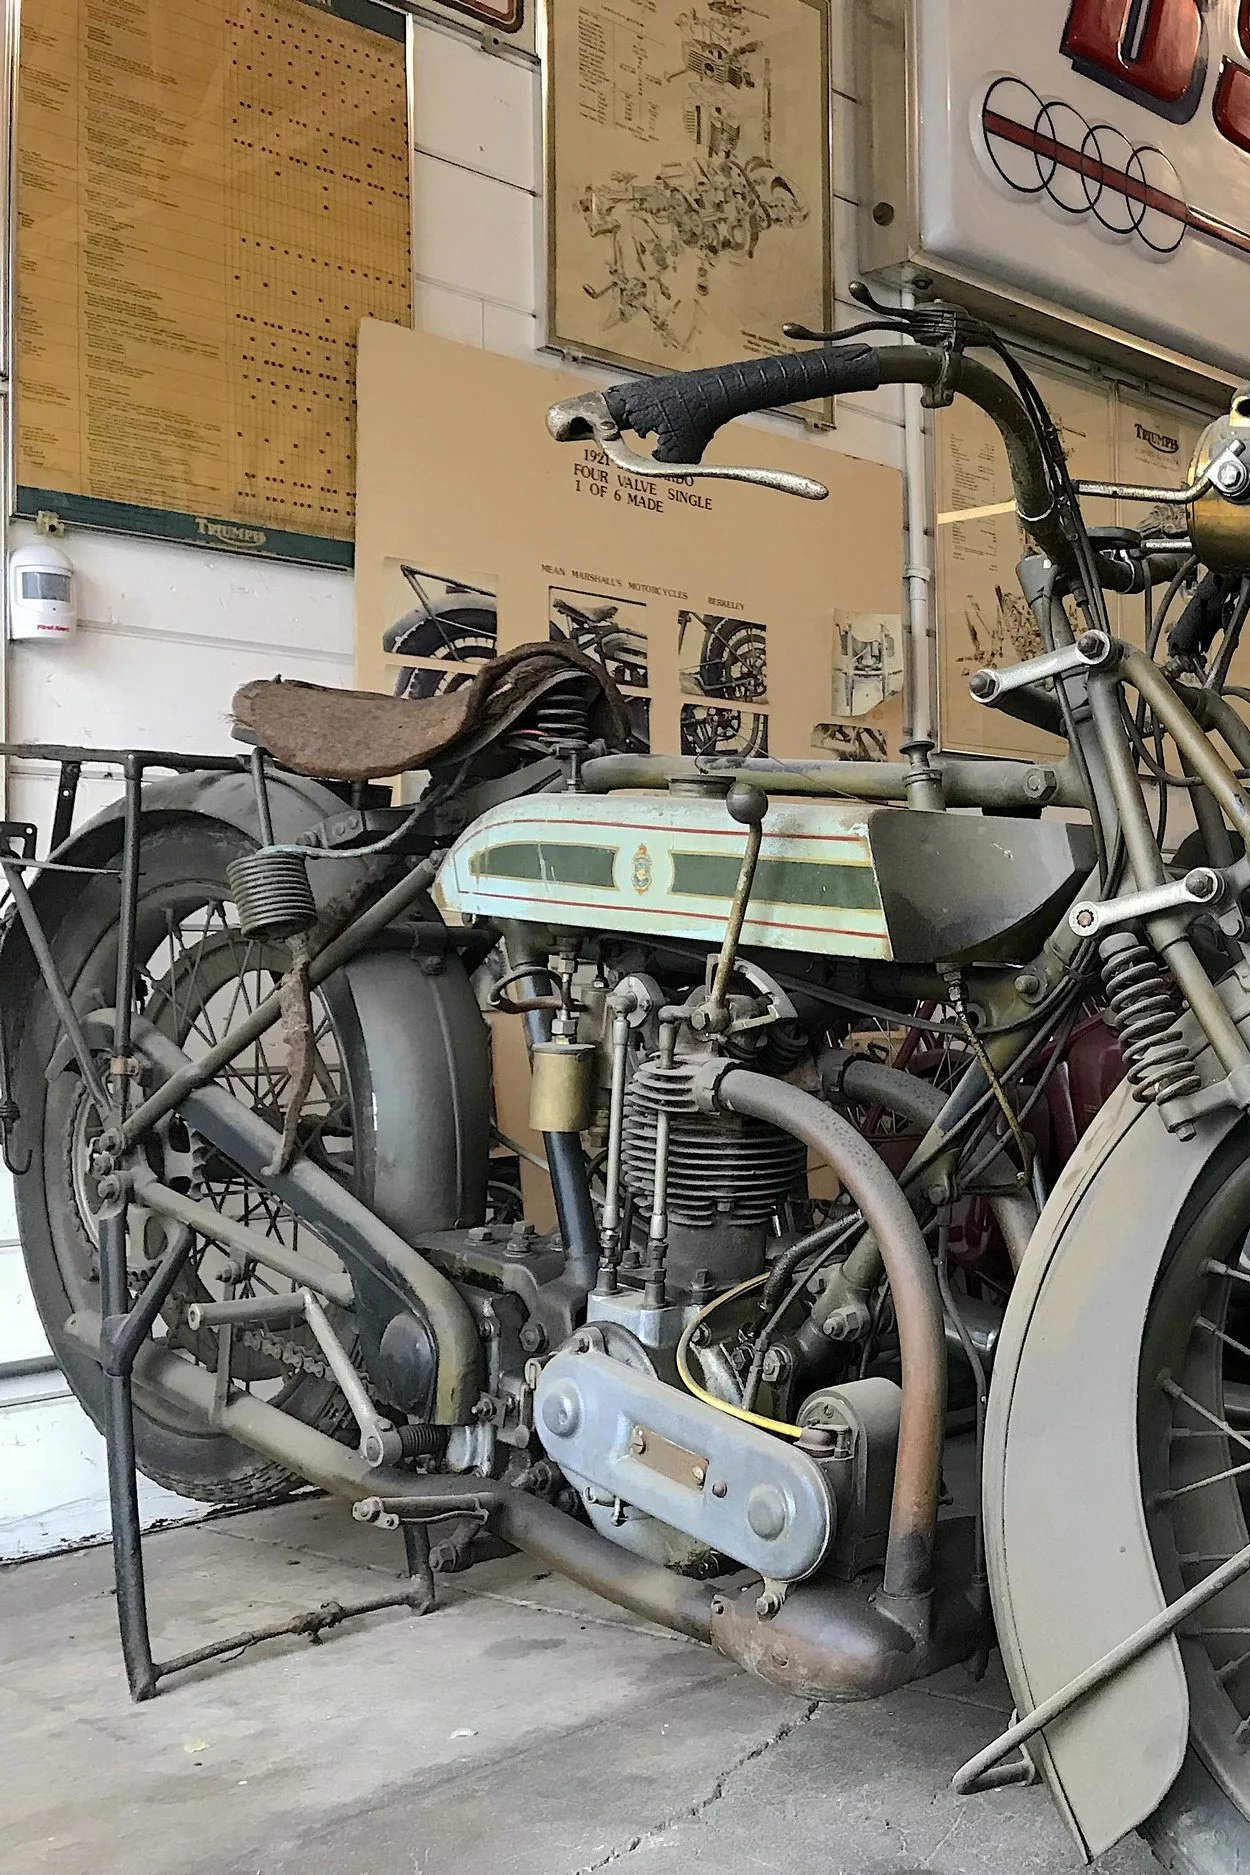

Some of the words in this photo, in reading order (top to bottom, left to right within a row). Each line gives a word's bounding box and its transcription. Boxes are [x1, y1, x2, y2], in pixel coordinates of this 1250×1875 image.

[1134, 423, 1180, 453] TRIUMPH
[574, 463, 608, 483] FOUR
[617, 474, 657, 496] VALVE
[667, 488, 713, 510] SINGLE
[575, 480, 581, 492] 1
[590, 483, 608, 498] OF
[614, 489, 622, 502] 6
[627, 492, 664, 513] MADE
[195, 518, 266, 546] TRIUMPH
[541, 564, 566, 576] MEAN
[571, 570, 623, 588] MARSHALL'S
[628, 581, 689, 600] MOTORCYCLES
[707, 596, 745, 611] BERKELEY
